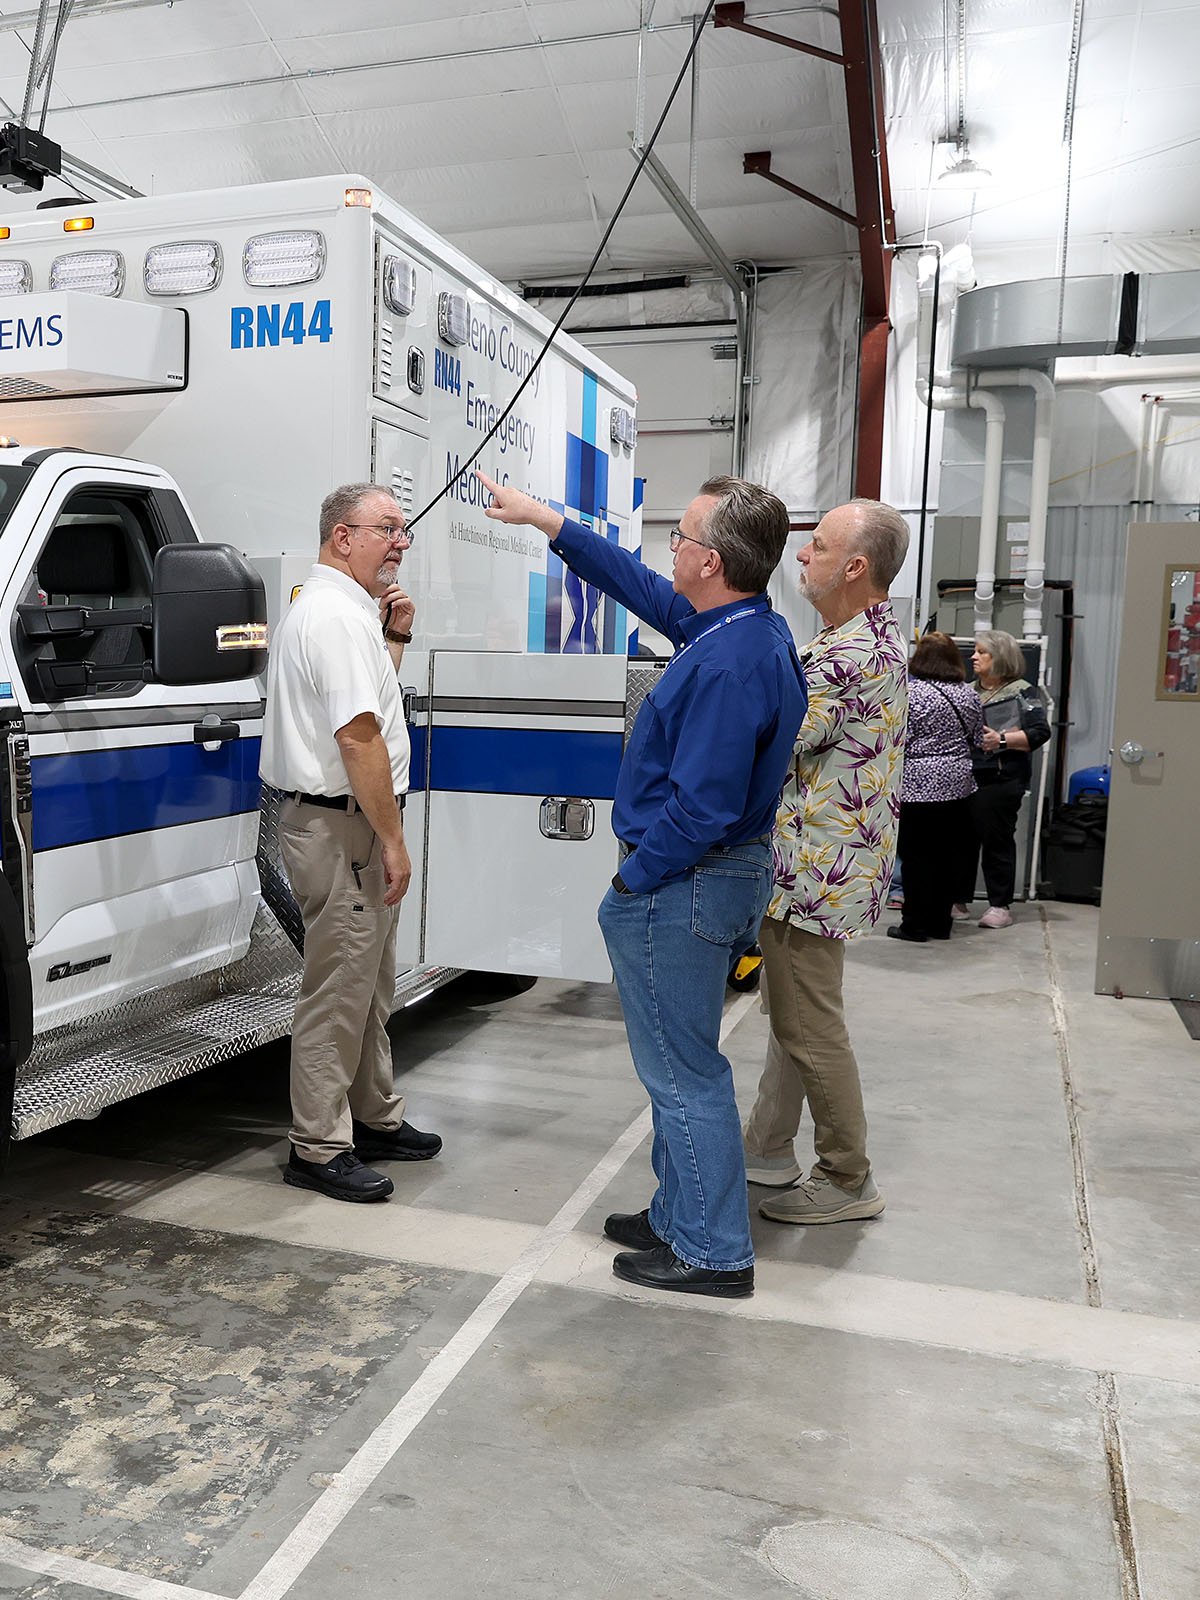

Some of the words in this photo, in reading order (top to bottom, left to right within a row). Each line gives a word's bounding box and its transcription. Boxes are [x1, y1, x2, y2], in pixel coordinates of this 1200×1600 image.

[230, 300, 333, 349] RN44
[468, 317, 496, 361] eno
[434, 348, 461, 397] RN44
[467, 381, 536, 464] Emergency
[8, 720, 23, 729] XLT
